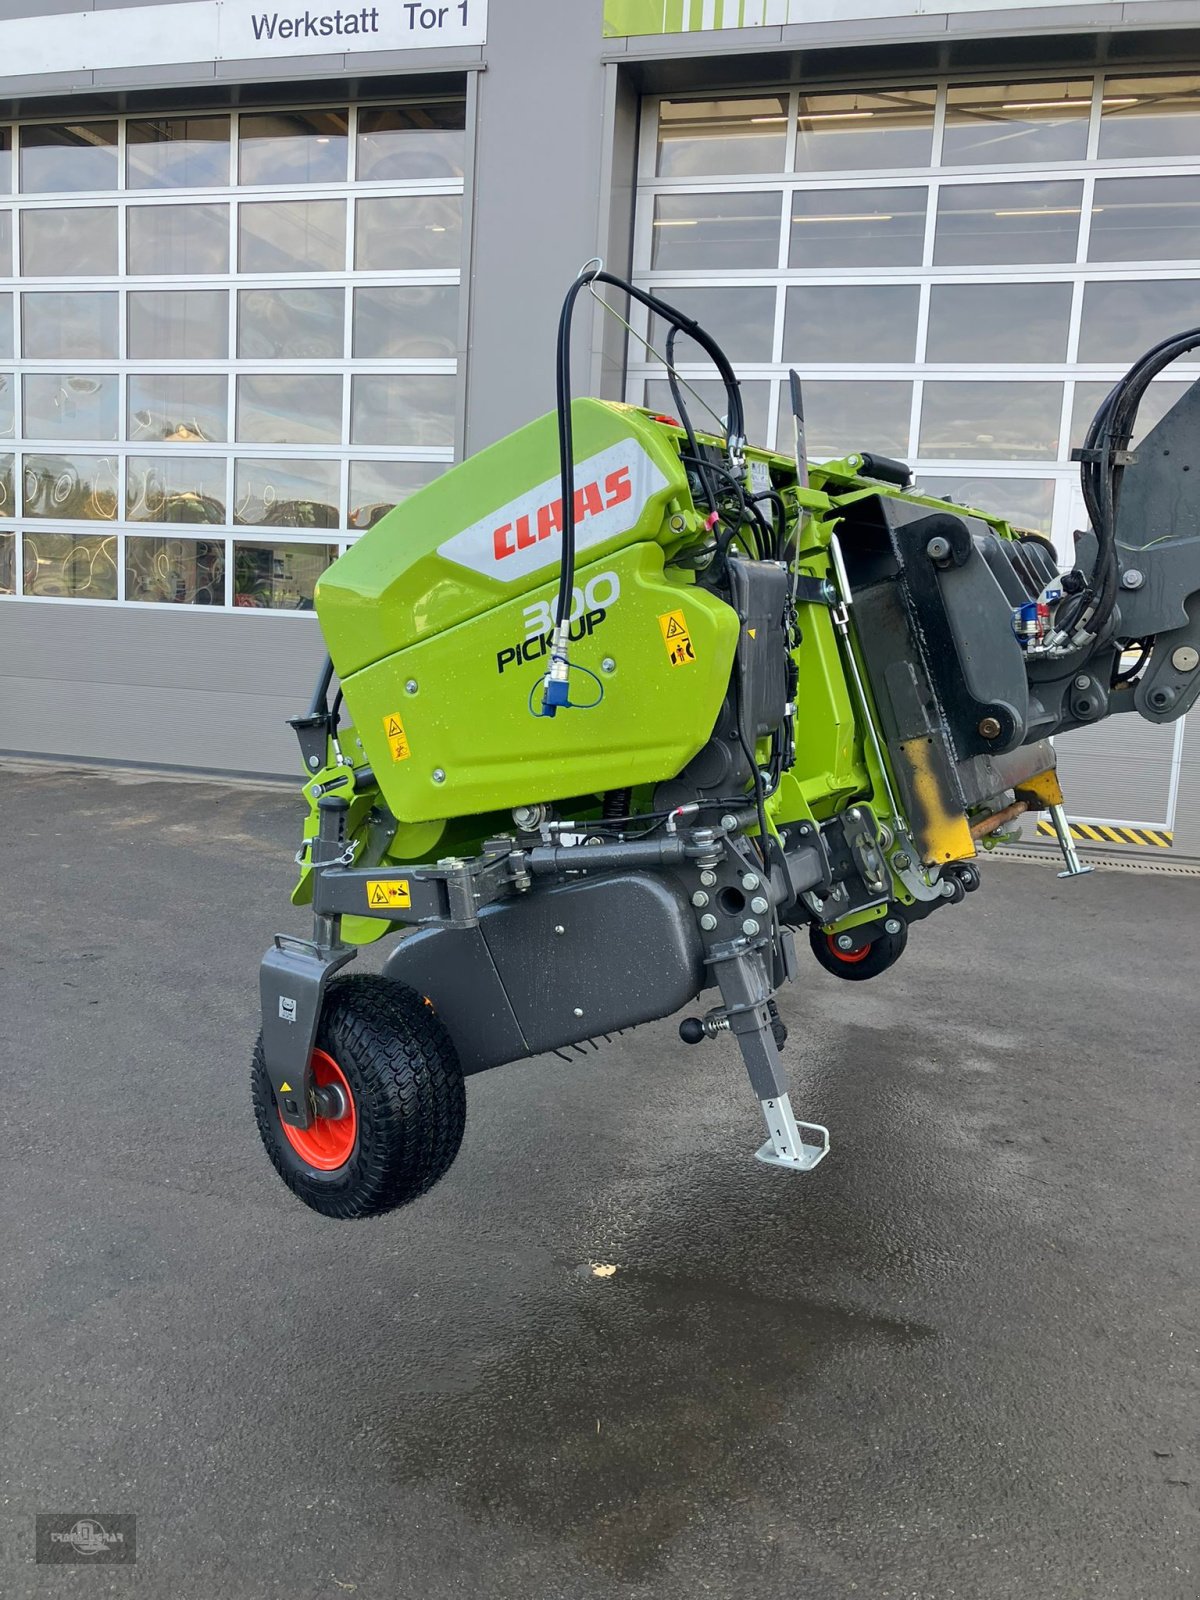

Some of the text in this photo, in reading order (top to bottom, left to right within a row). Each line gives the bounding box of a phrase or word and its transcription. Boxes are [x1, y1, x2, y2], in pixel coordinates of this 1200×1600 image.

[251, 0, 469, 40] Werkstatt Tor 1
[493, 465, 632, 561] CLAAS
[522, 570, 621, 641] 300
[767, 1101, 774, 1109] 2
